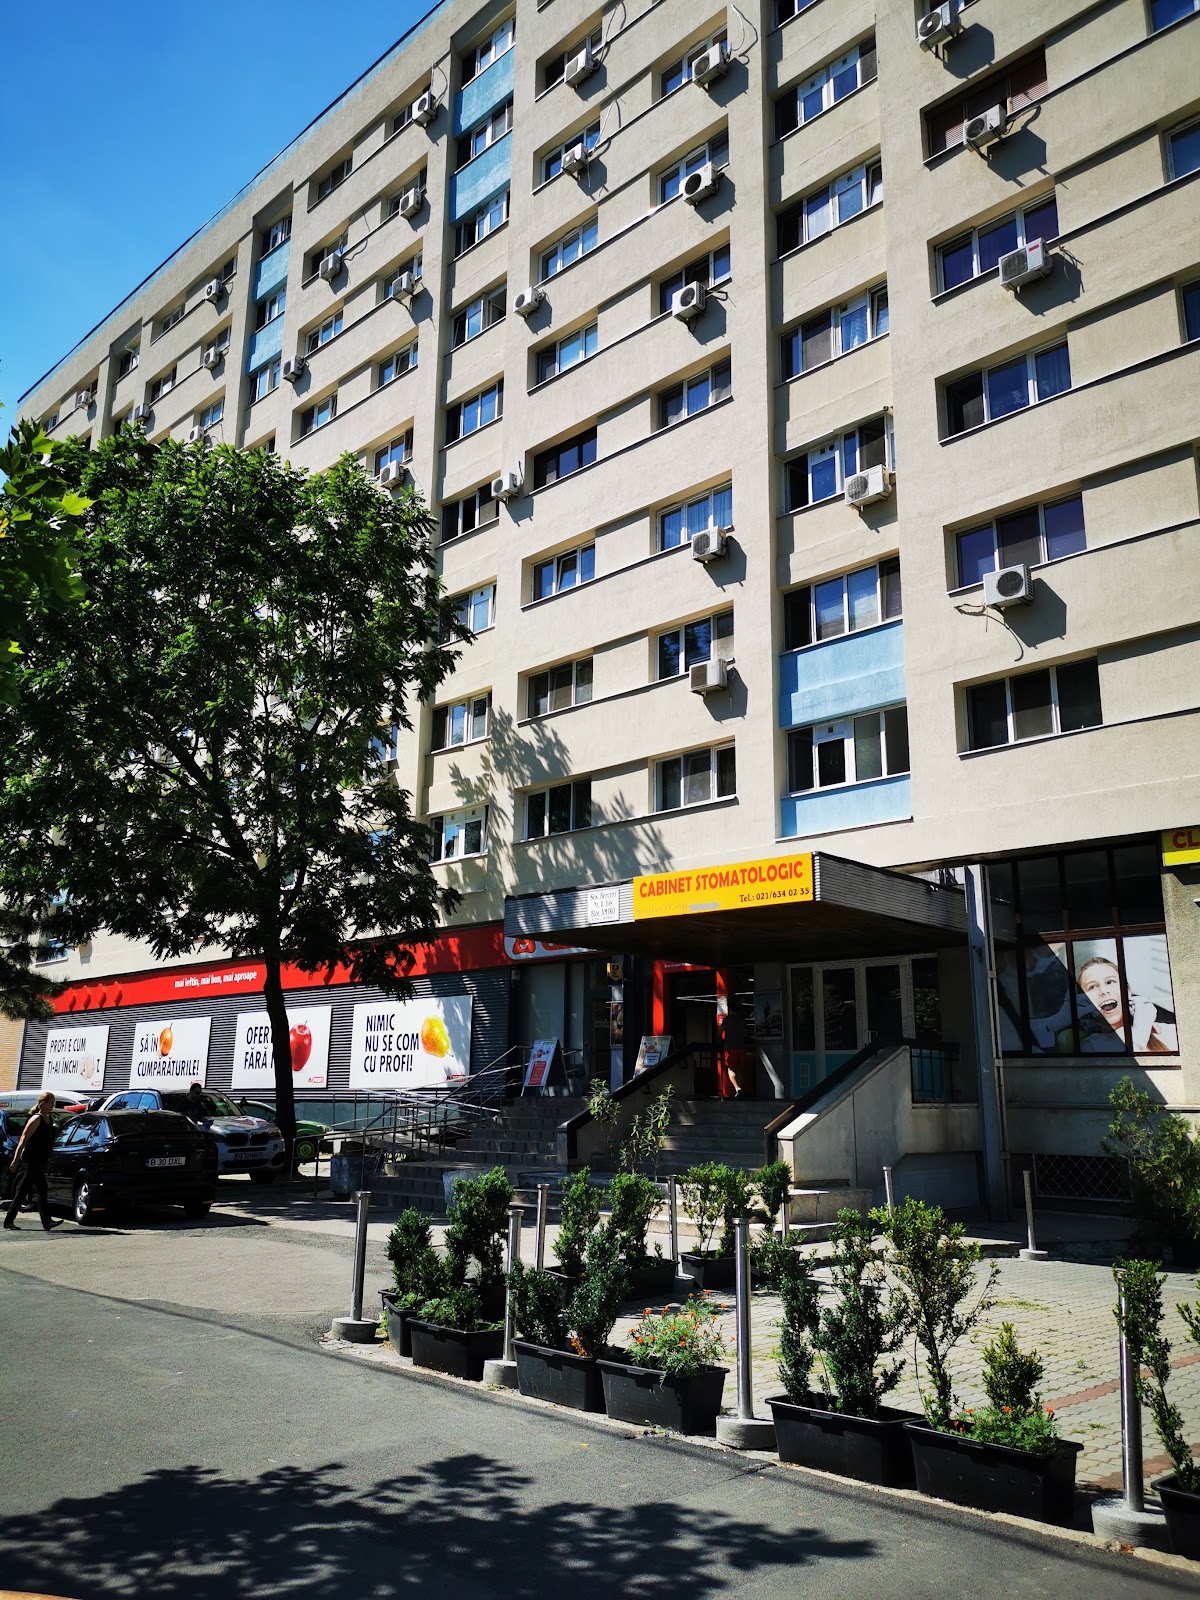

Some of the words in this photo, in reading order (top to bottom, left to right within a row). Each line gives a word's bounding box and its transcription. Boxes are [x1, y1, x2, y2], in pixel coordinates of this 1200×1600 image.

[1172, 831, 1200, 849] CL
[639, 876, 692, 898] CABINET
[695, 861, 803, 891] STOMATOLOGIC
[739, 893, 755, 902] Tel.:
[756, 890, 786, 901] 021/634
[788, 888, 797, 896] 02
[800, 887, 810, 895] 35
[174, 978, 184, 988] mai
[185, 976, 200, 987] ieftin,
[201, 975, 211, 985] mai
[211, 974, 222, 984] bun,
[223, 971, 234, 982] mai
[234, 971, 257, 983] aproape
[366, 1013, 395, 1032] NIMIC
[140, 1033, 149, 1052] SĂ
[246, 1026, 273, 1044] OFER
[365, 1035, 379, 1052] NU
[382, 1034, 393, 1051] SE
[396, 1033, 419, 1051] COM
[50, 1039, 67, 1053] PROFI
[68, 1038, 72, 1052] E
[73, 1038, 86, 1051] CUM
[137, 1056, 200, 1077] CUMPĂRĂTURILE!
[244, 1045, 268, 1069] FĂRĂ
[364, 1055, 376, 1073] CU
[379, 1054, 413, 1072] PROFI!
